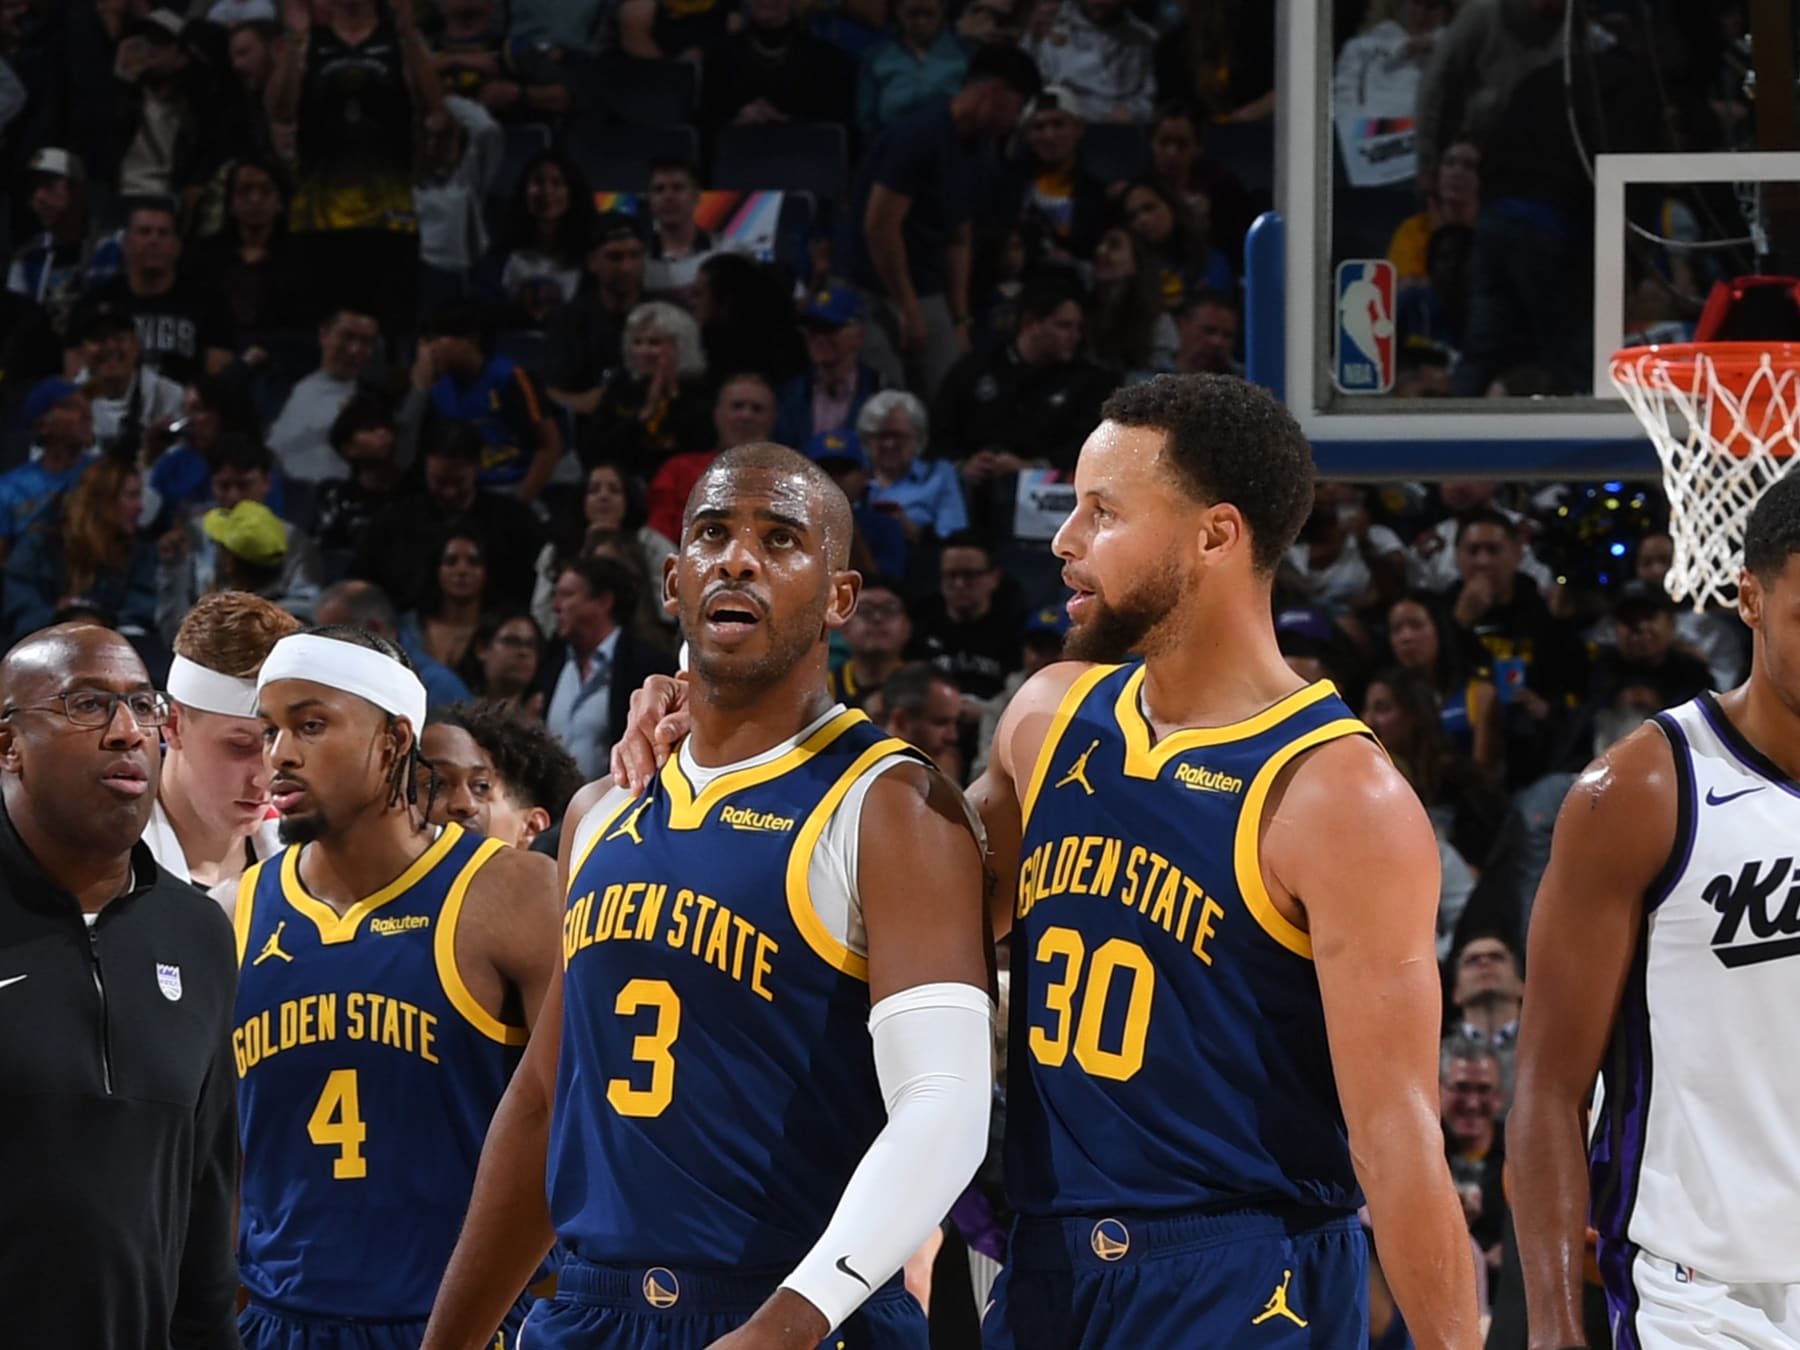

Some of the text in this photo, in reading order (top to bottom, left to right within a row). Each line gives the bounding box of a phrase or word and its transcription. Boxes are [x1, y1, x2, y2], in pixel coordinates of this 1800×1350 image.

[719, 805, 795, 831] Rakuten
[1174, 762, 1242, 793] Rakuten
[370, 915, 429, 936] Rakuten
[667, 889, 779, 1002] STATE
[1017, 836, 1224, 966] GOLDEN STATE
[232, 992, 440, 1079] GOLDEN STATE
[606, 978, 681, 1118] 3
[1029, 925, 1155, 1082] 30
[306, 1068, 367, 1180] 4
